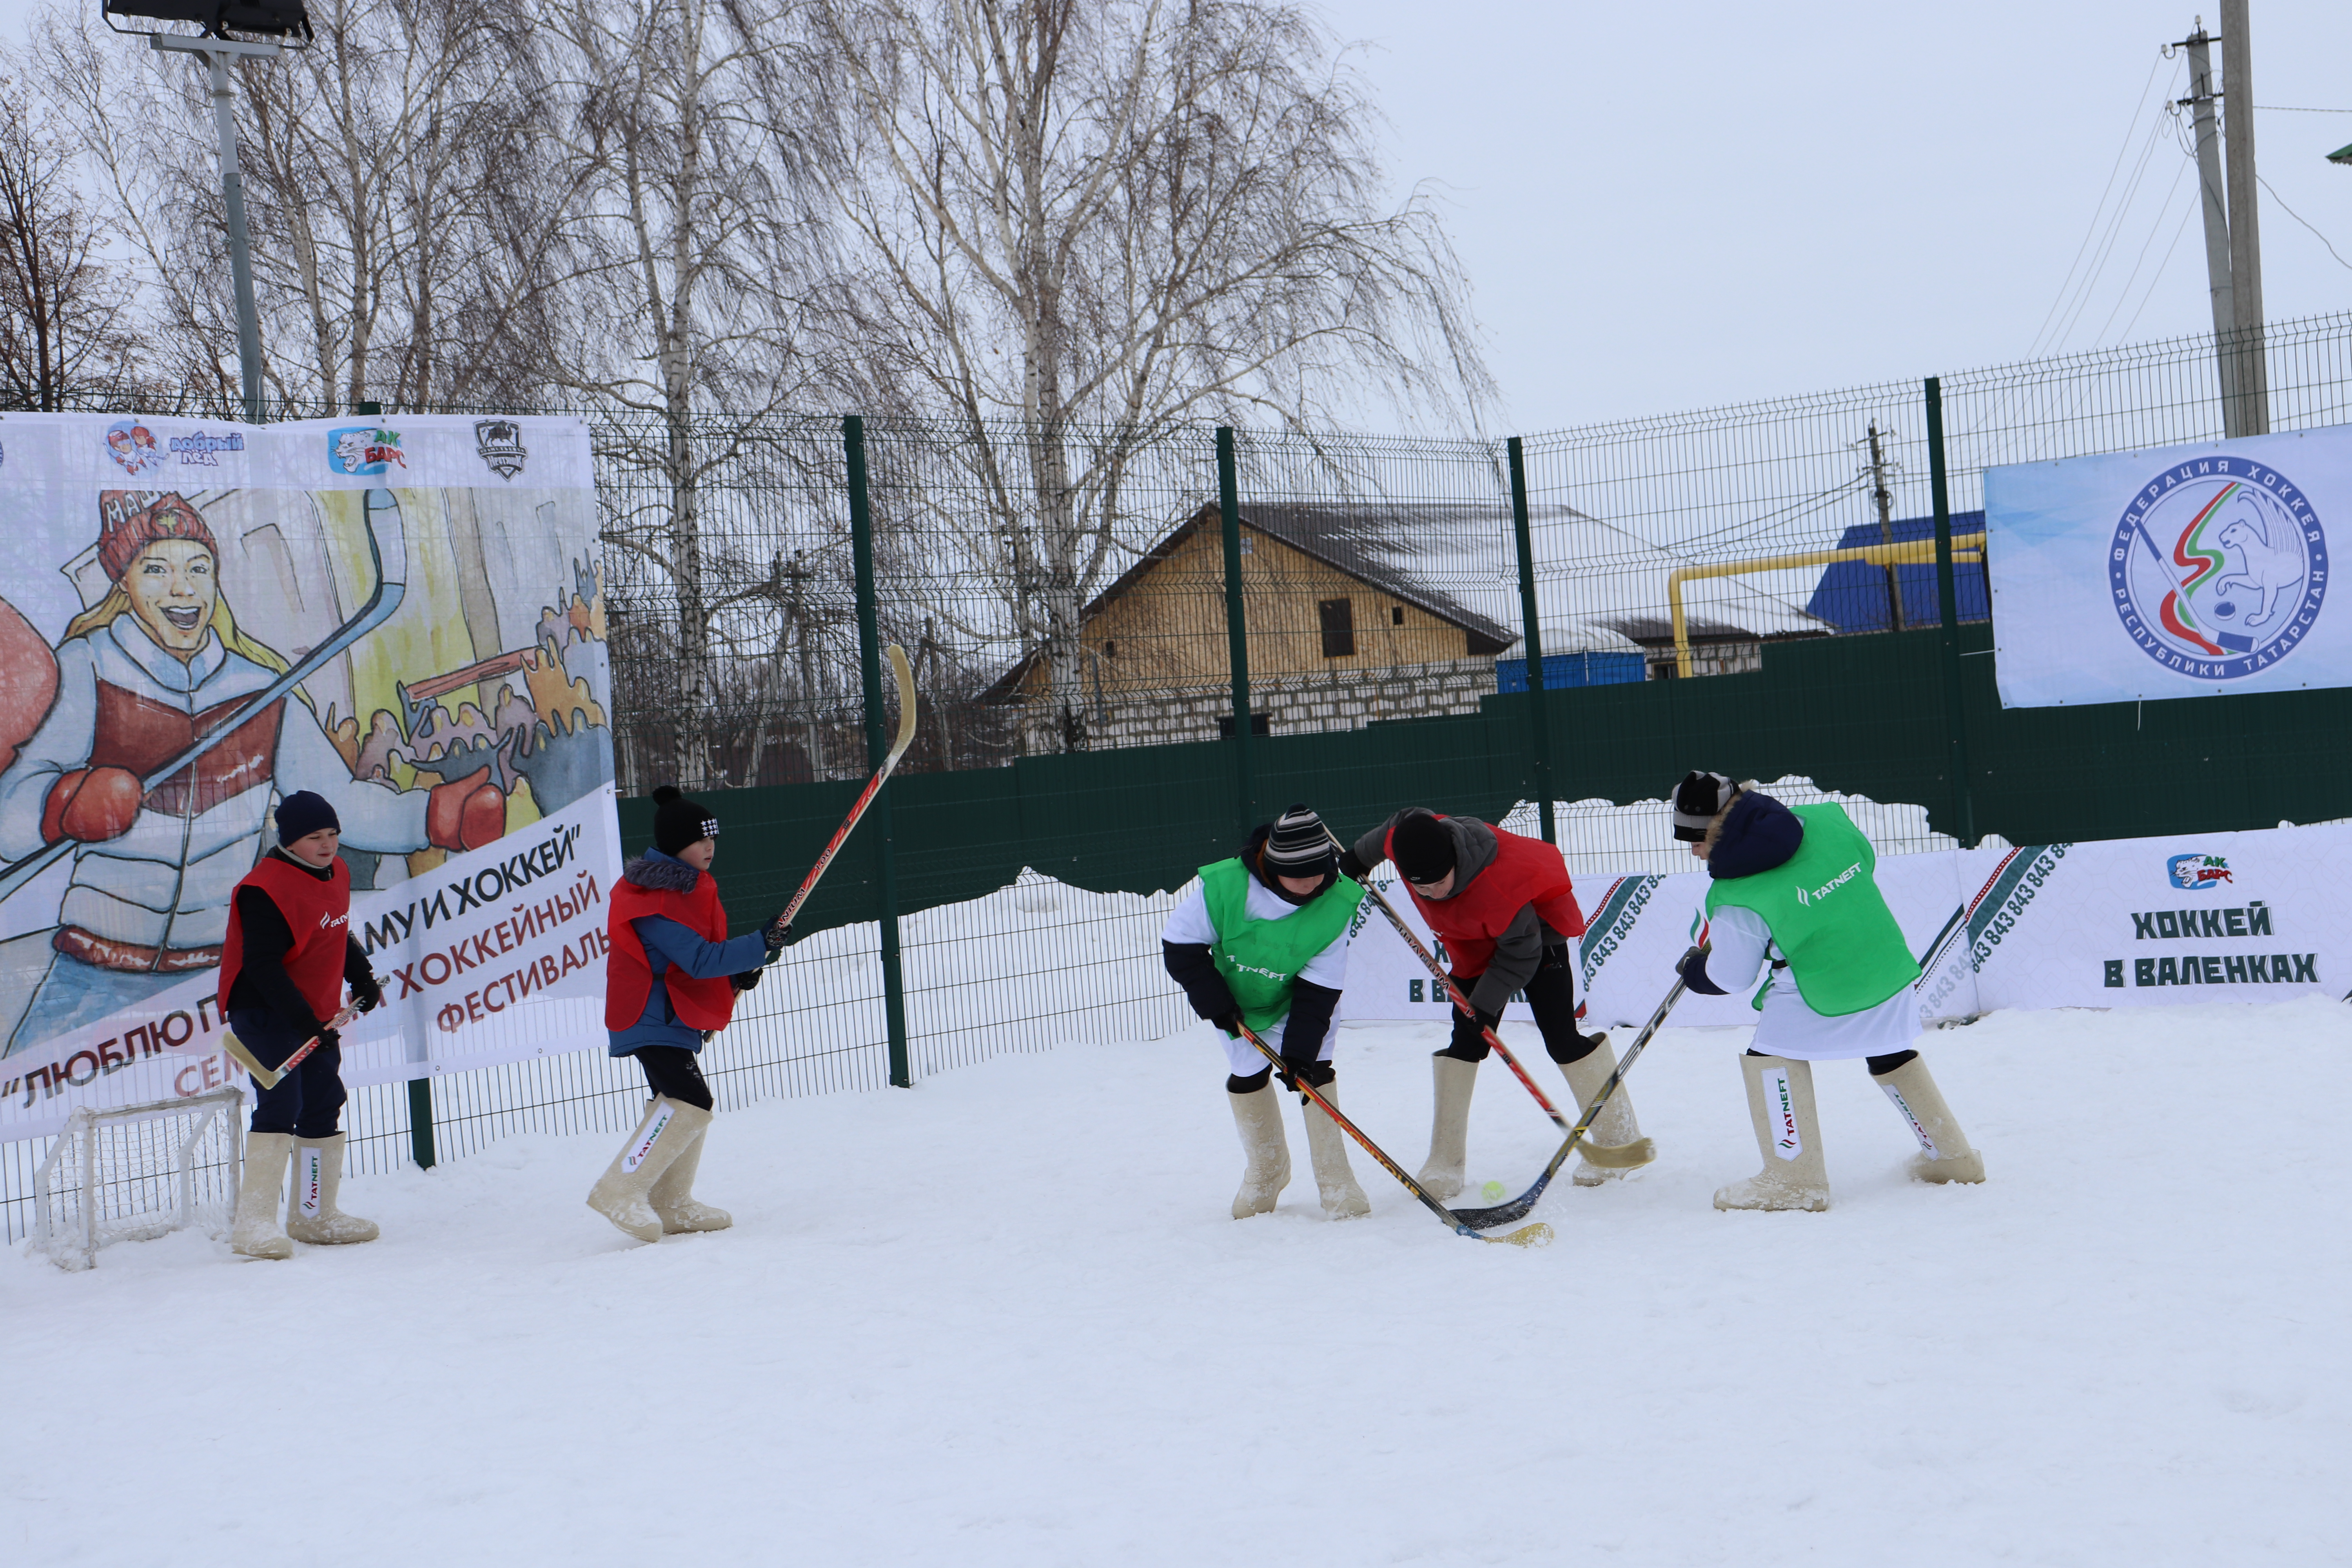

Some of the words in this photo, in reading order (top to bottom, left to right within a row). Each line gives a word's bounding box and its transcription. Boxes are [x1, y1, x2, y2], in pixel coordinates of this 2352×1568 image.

[364, 447, 407, 469] БАРС
[374, 430, 400, 447] АК
[2114, 460, 2229, 561] ФЕДЕРАЦИЯ
[2247, 466, 2321, 543] ХОККЕЯ
[2115, 589, 2225, 676] РЕСПУБЛИКИ
[2243, 570, 2325, 671] ТАТАРСТАН
[1811, 862, 1862, 900] TATNEFT
[2196, 868, 2233, 884] БАРС
[2202, 855, 2227, 869] АК
[421, 889, 452, 929] И
[1984, 911, 2015, 945] 843
[2007, 883, 2035, 916] 843
[2026, 854, 2056, 887] 843
[2131, 900, 2274, 940] ХОККЕЙ
[392, 869, 601, 1000] ХОККЕЙНЫЙ
[1591, 936, 1618, 967] 843
[1612, 911, 1636, 940] 843
[1628, 885, 1651, 915] 843
[1398, 923, 1450, 990] TITANIUM
[2103, 959, 2126, 987] В
[2134, 953, 2321, 987] ВАЛЕНКАХ
[436, 927, 610, 1034] ФЕСТИВАЛЬ
[1777, 1078, 1795, 1136] TATNEFT
[637, 1114, 668, 1158] TATNEFT
[1338, 1120, 1420, 1197] CONTOUR
[310, 1156, 319, 1201] TATNEFT
